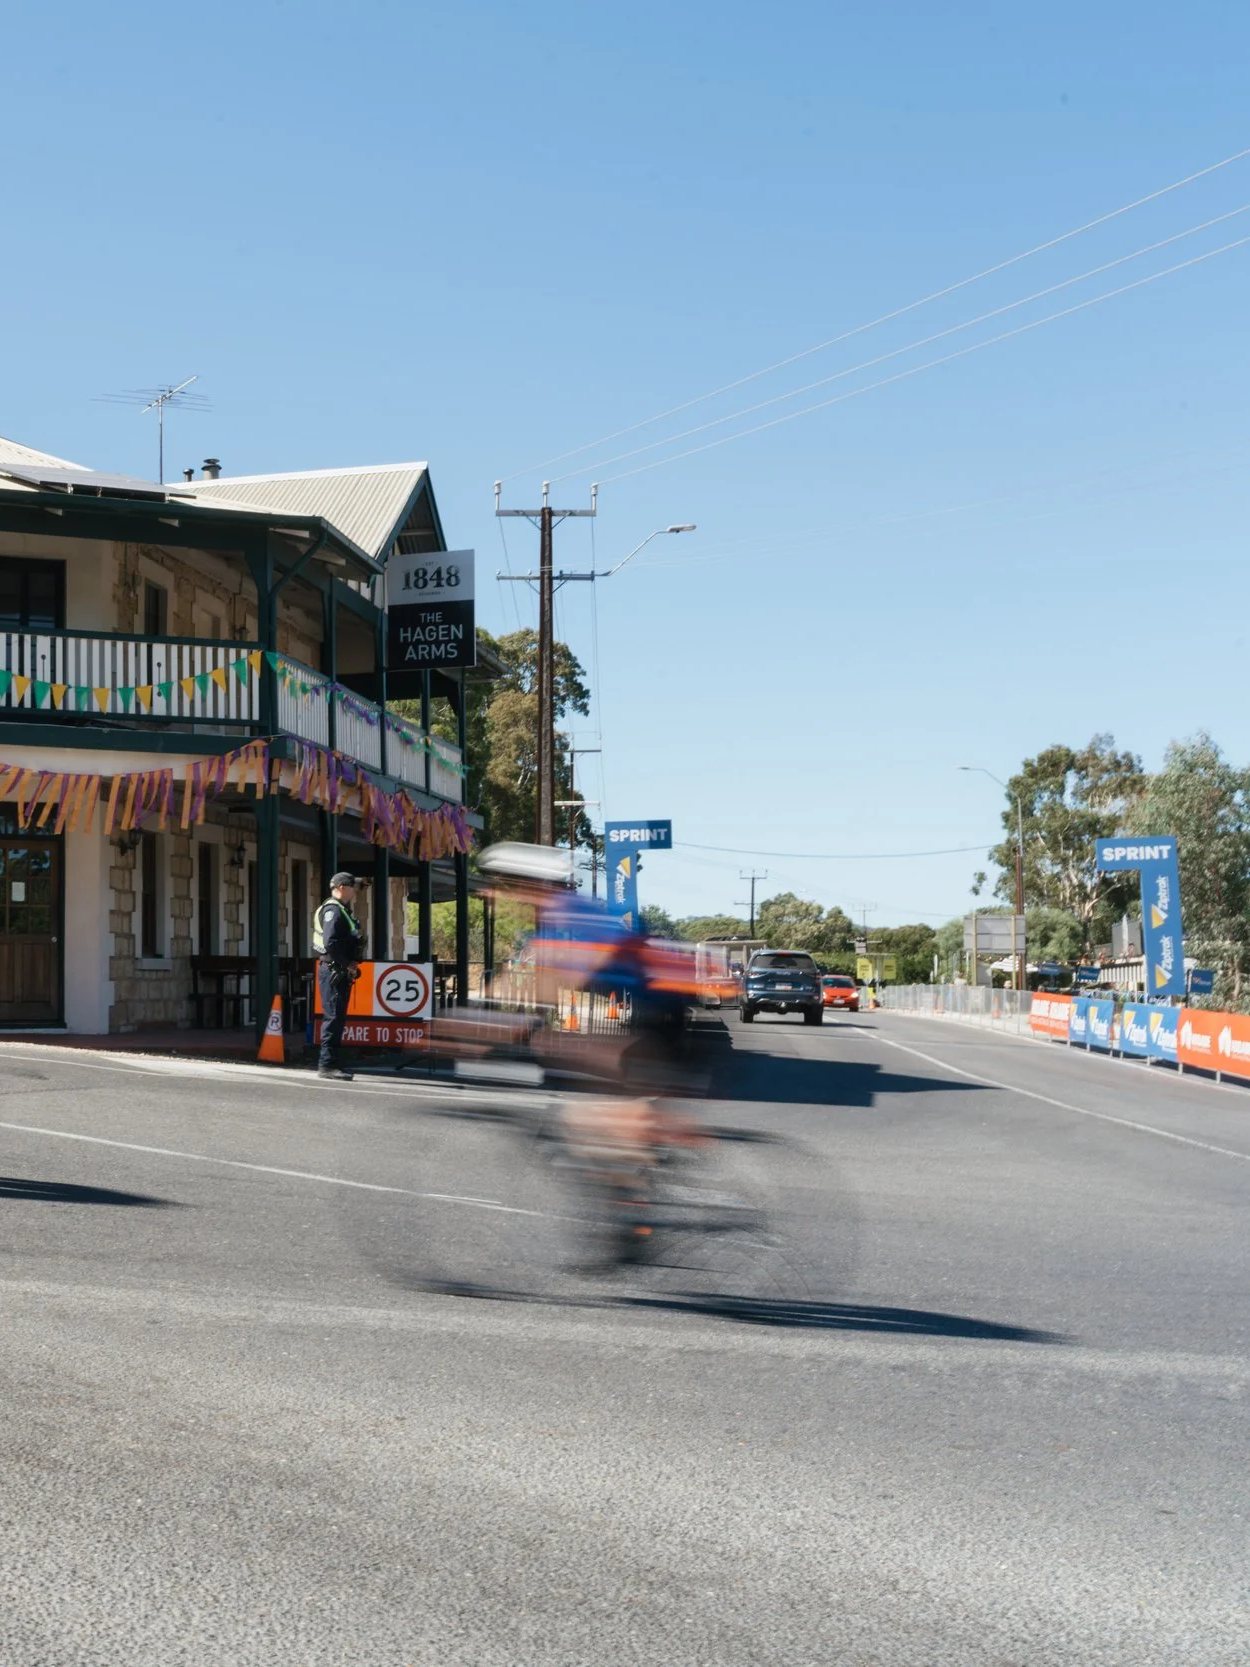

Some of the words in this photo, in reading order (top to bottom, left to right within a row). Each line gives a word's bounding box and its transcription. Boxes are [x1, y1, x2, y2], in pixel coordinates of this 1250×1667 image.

[402, 565, 461, 591] 1848
[419, 612, 443, 623] THE
[399, 624, 463, 643] HAGEN
[404, 643, 458, 661] ARMS
[609, 828, 668, 843] SPRINT
[1102, 845, 1172, 862] SPRINT
[385, 979, 420, 1002] 25
[341, 1025, 370, 1042] PARE
[375, 1027, 390, 1042] TO
[396, 1028, 424, 1044] STOP
